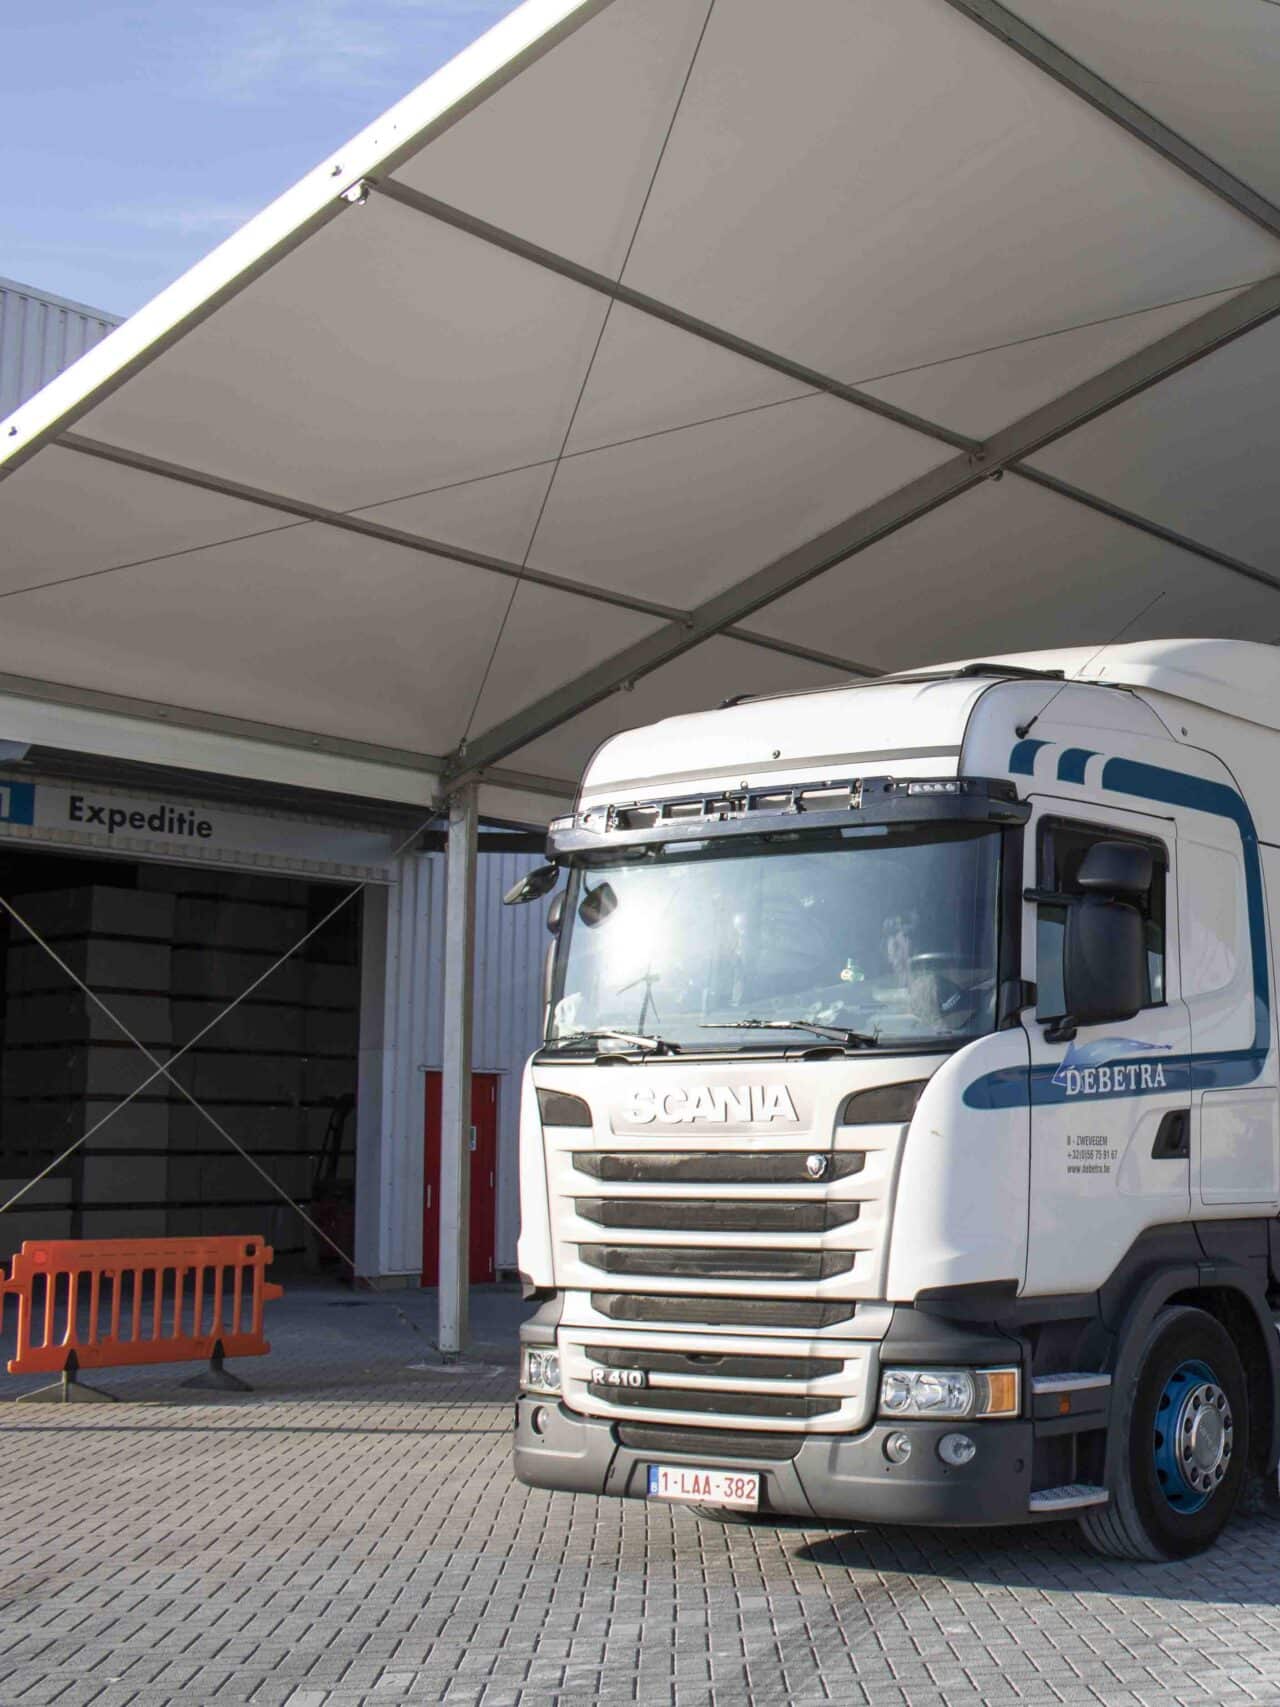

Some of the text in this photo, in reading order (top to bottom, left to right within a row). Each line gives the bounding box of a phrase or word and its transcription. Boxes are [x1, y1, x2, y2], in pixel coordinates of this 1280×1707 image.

[69, 795, 213, 838] Expeditie
[1065, 1063, 1167, 1095] DEBETRA
[622, 1085, 800, 1124] SCANIA
[592, 1369, 642, 1387] R 410
[662, 1472, 756, 1499] 1-LAA-382
